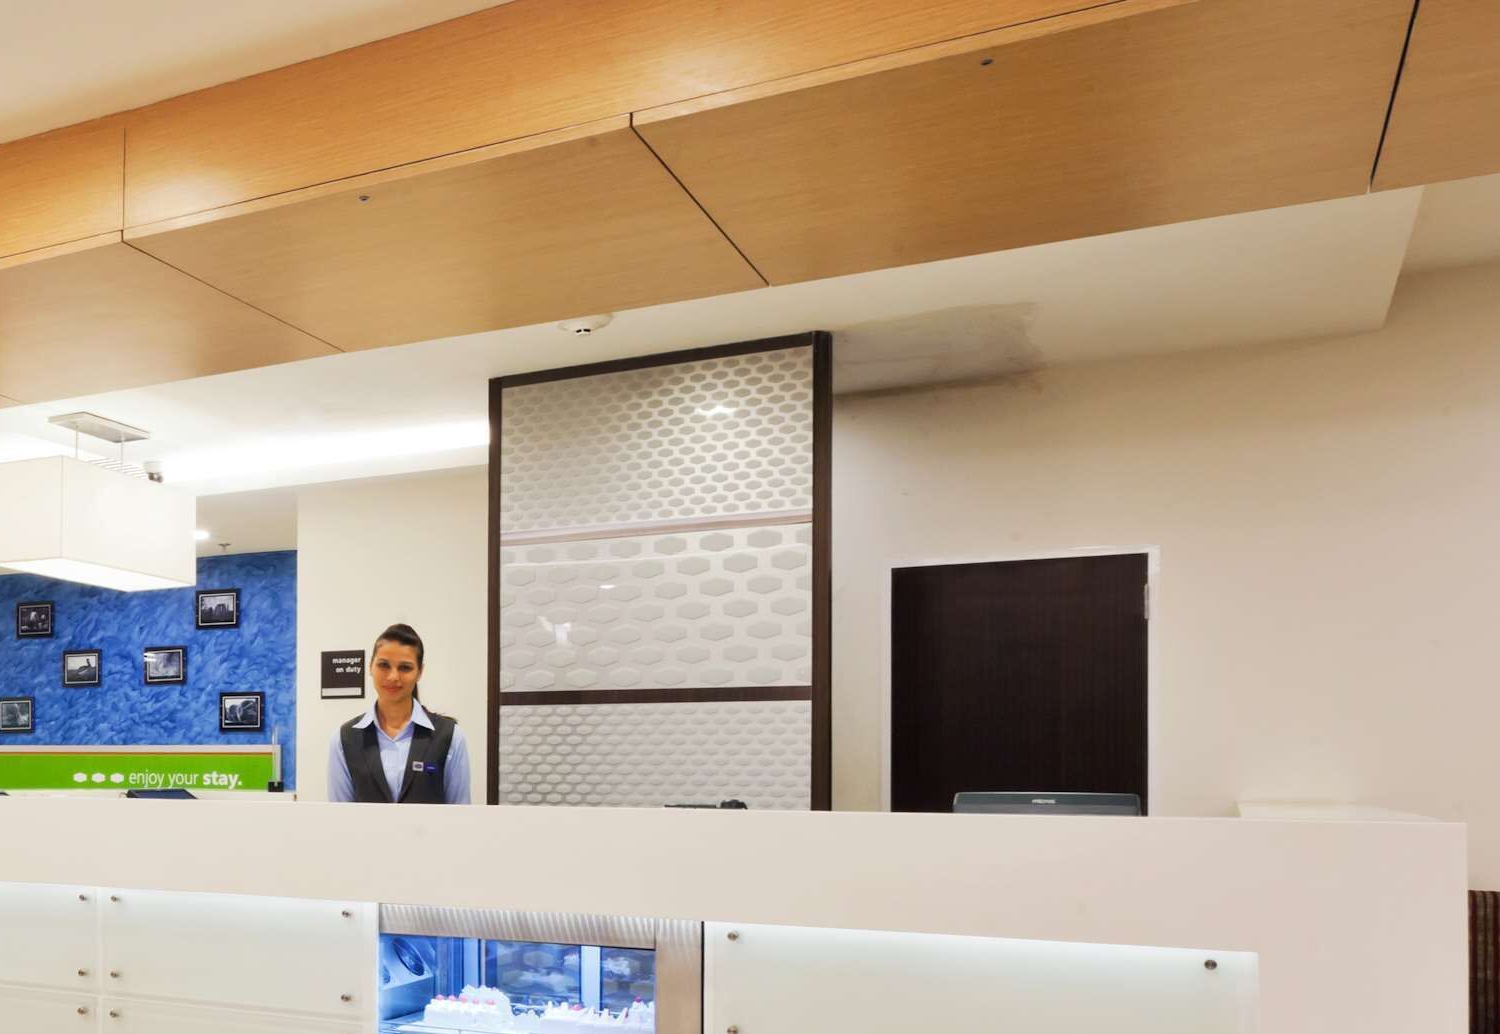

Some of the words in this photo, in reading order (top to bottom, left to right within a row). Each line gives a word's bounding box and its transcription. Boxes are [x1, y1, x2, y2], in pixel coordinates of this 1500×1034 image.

[332, 657, 361, 665] manager
[345, 666, 361, 674] duty
[129, 770, 164, 789] enjoy
[168, 772, 198, 789] your
[203, 771, 242, 789] stay.
